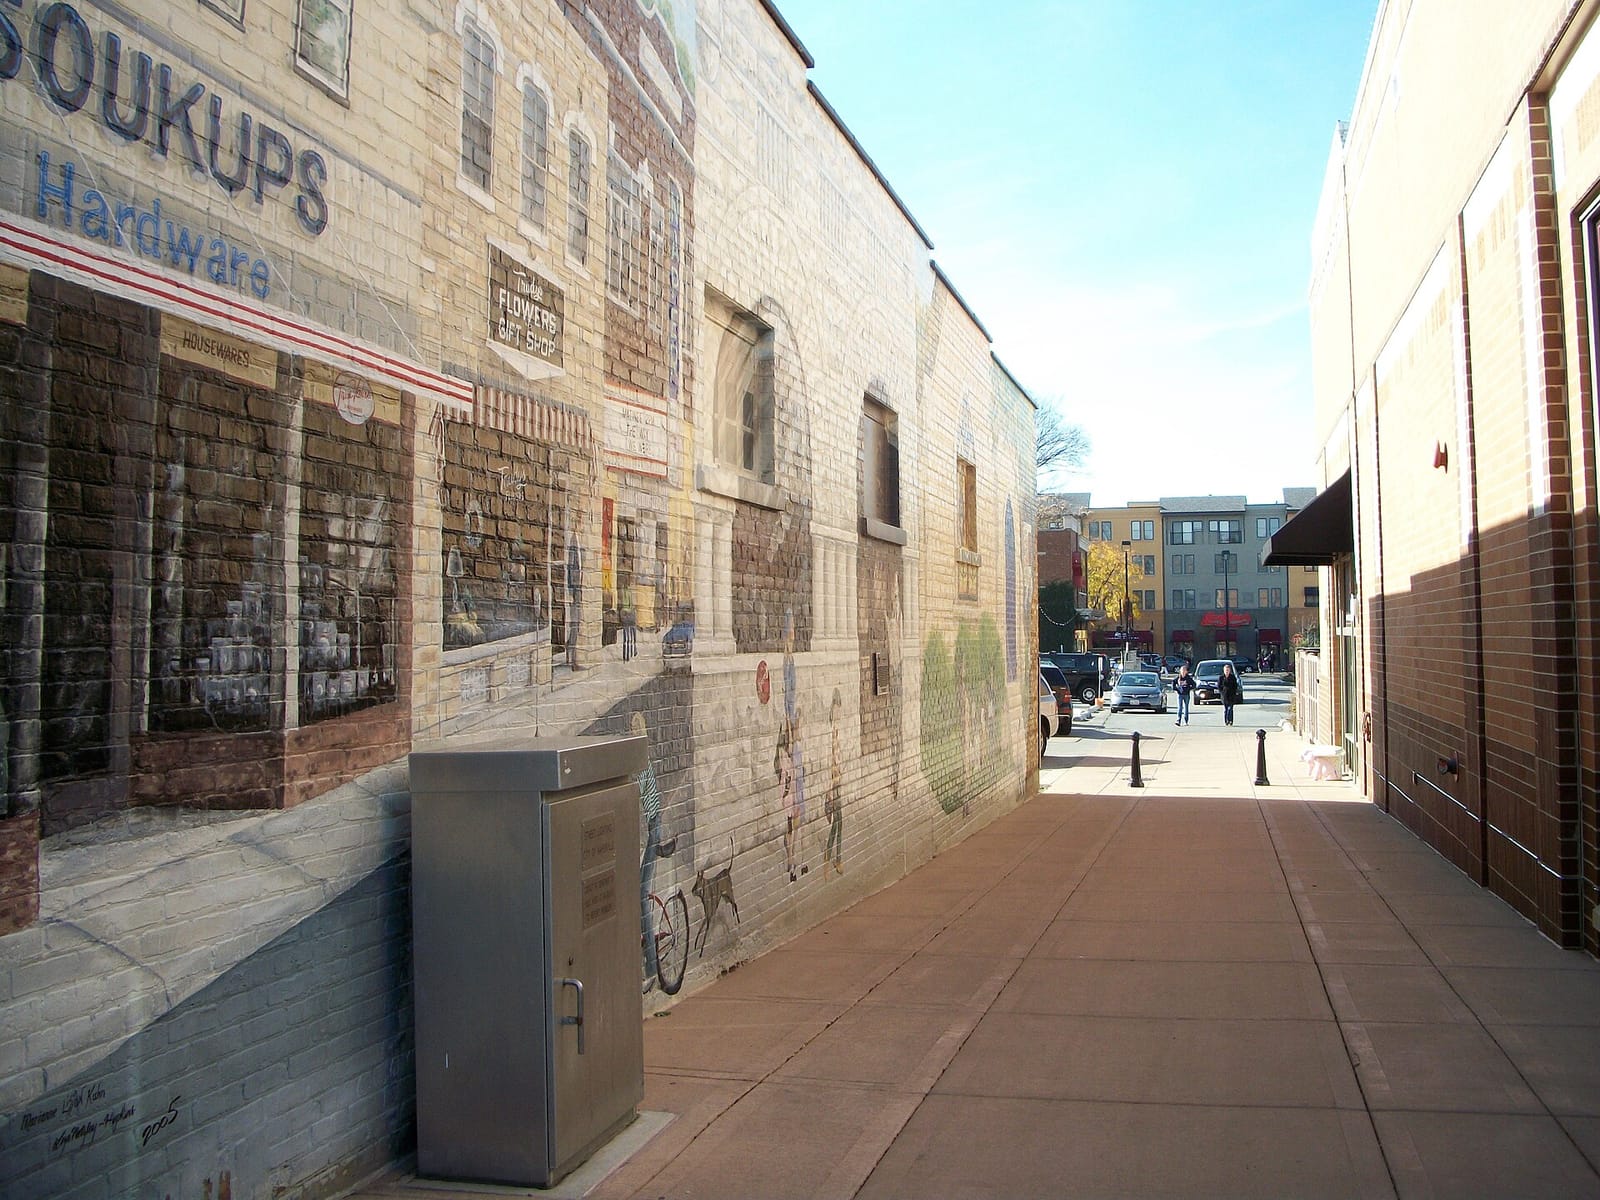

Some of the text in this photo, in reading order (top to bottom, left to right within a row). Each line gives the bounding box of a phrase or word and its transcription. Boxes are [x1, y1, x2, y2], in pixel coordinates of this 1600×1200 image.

[38, 150, 271, 299] Hardware
[499, 287, 557, 335] FLOWERS
[183, 330, 250, 368] HOUSEWARES
[498, 317, 556, 357] GIFT SHOP
[142, 1095, 181, 1147] 2005
